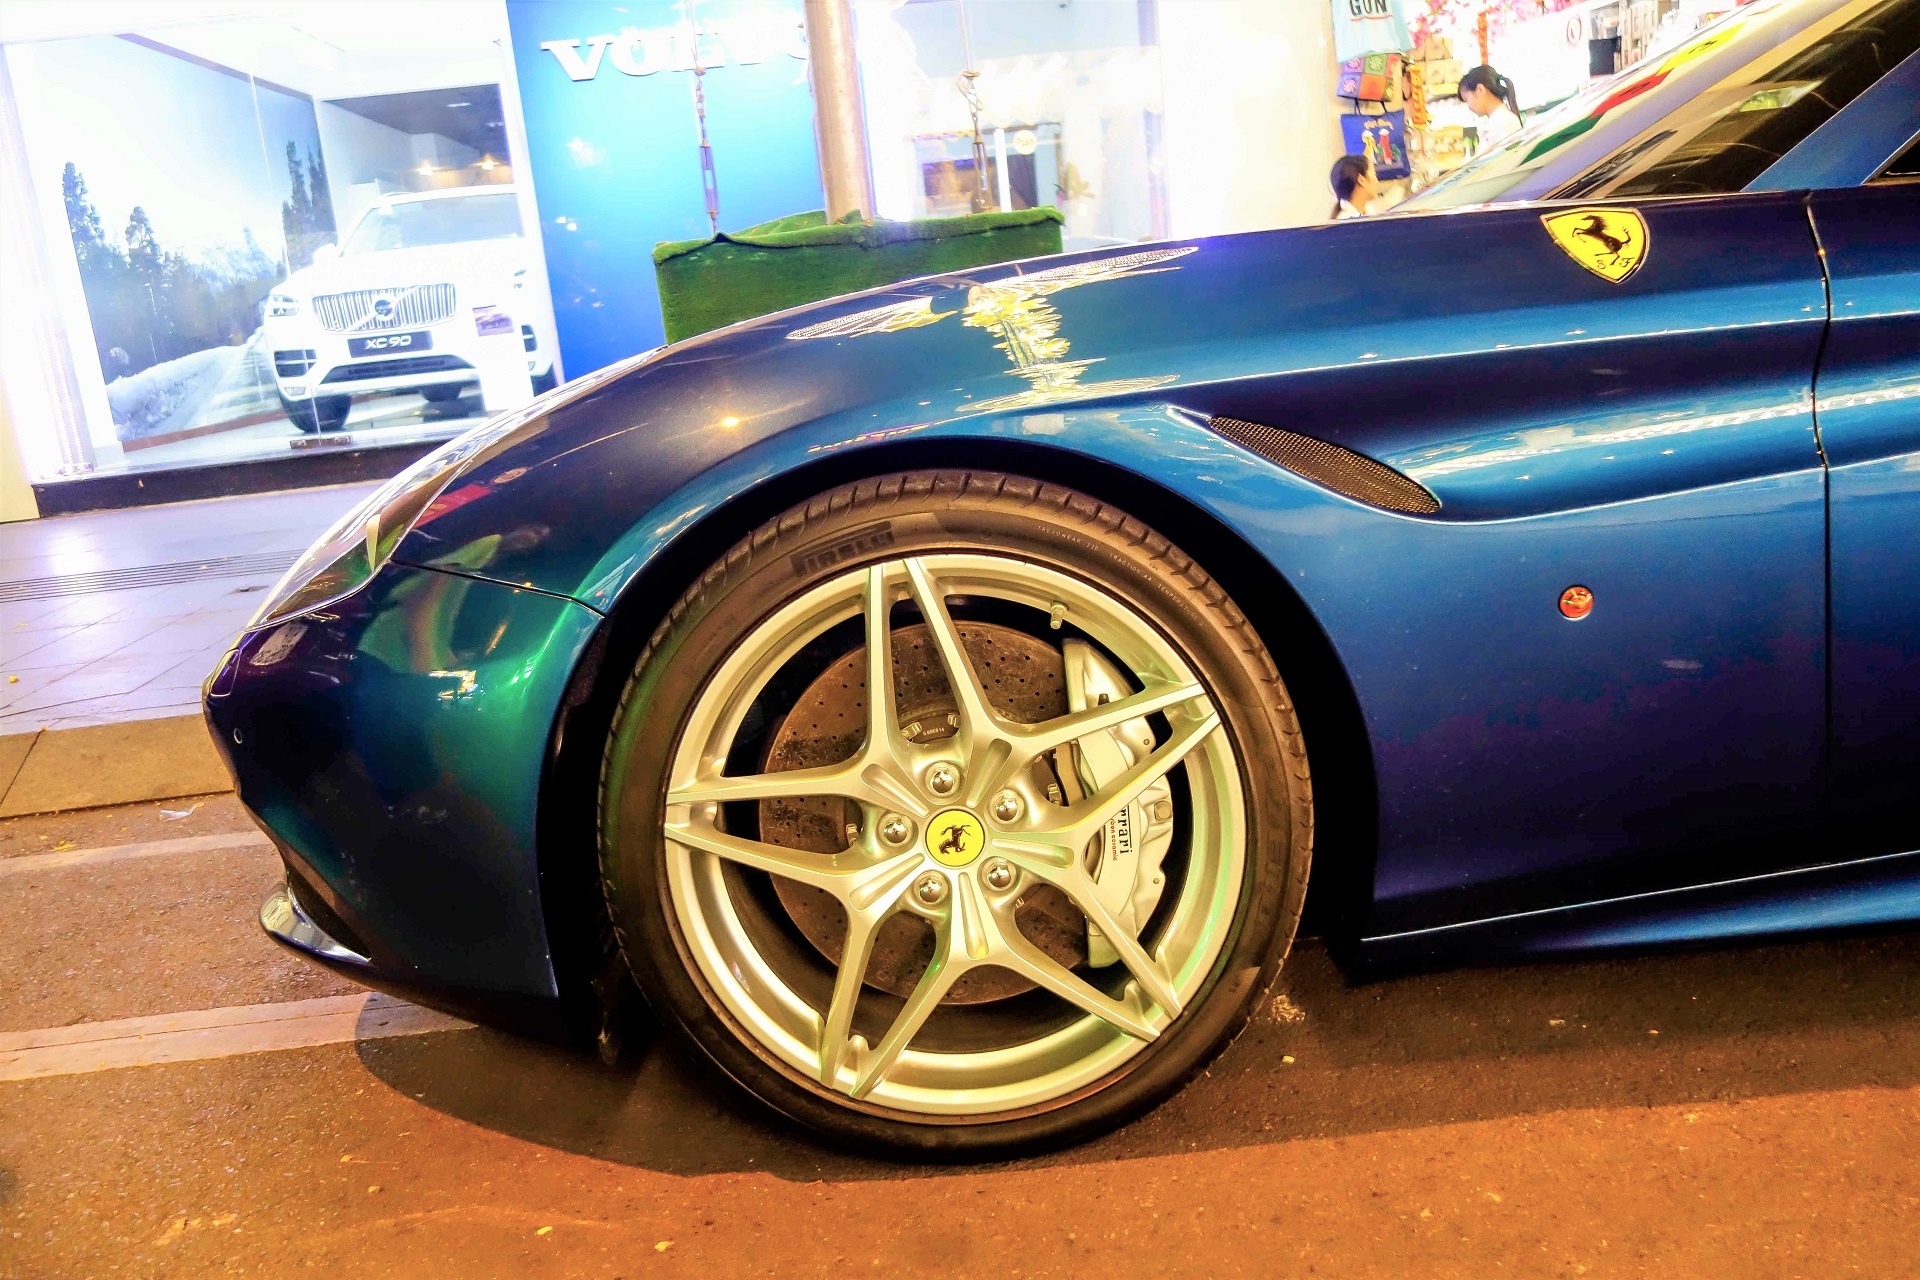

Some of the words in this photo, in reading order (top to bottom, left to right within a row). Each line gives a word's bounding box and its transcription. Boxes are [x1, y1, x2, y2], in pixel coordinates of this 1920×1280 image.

[365, 338, 388, 350] XC
[390, 335, 412, 347] 90
[1109, 553, 1141, 574] TRACTION
